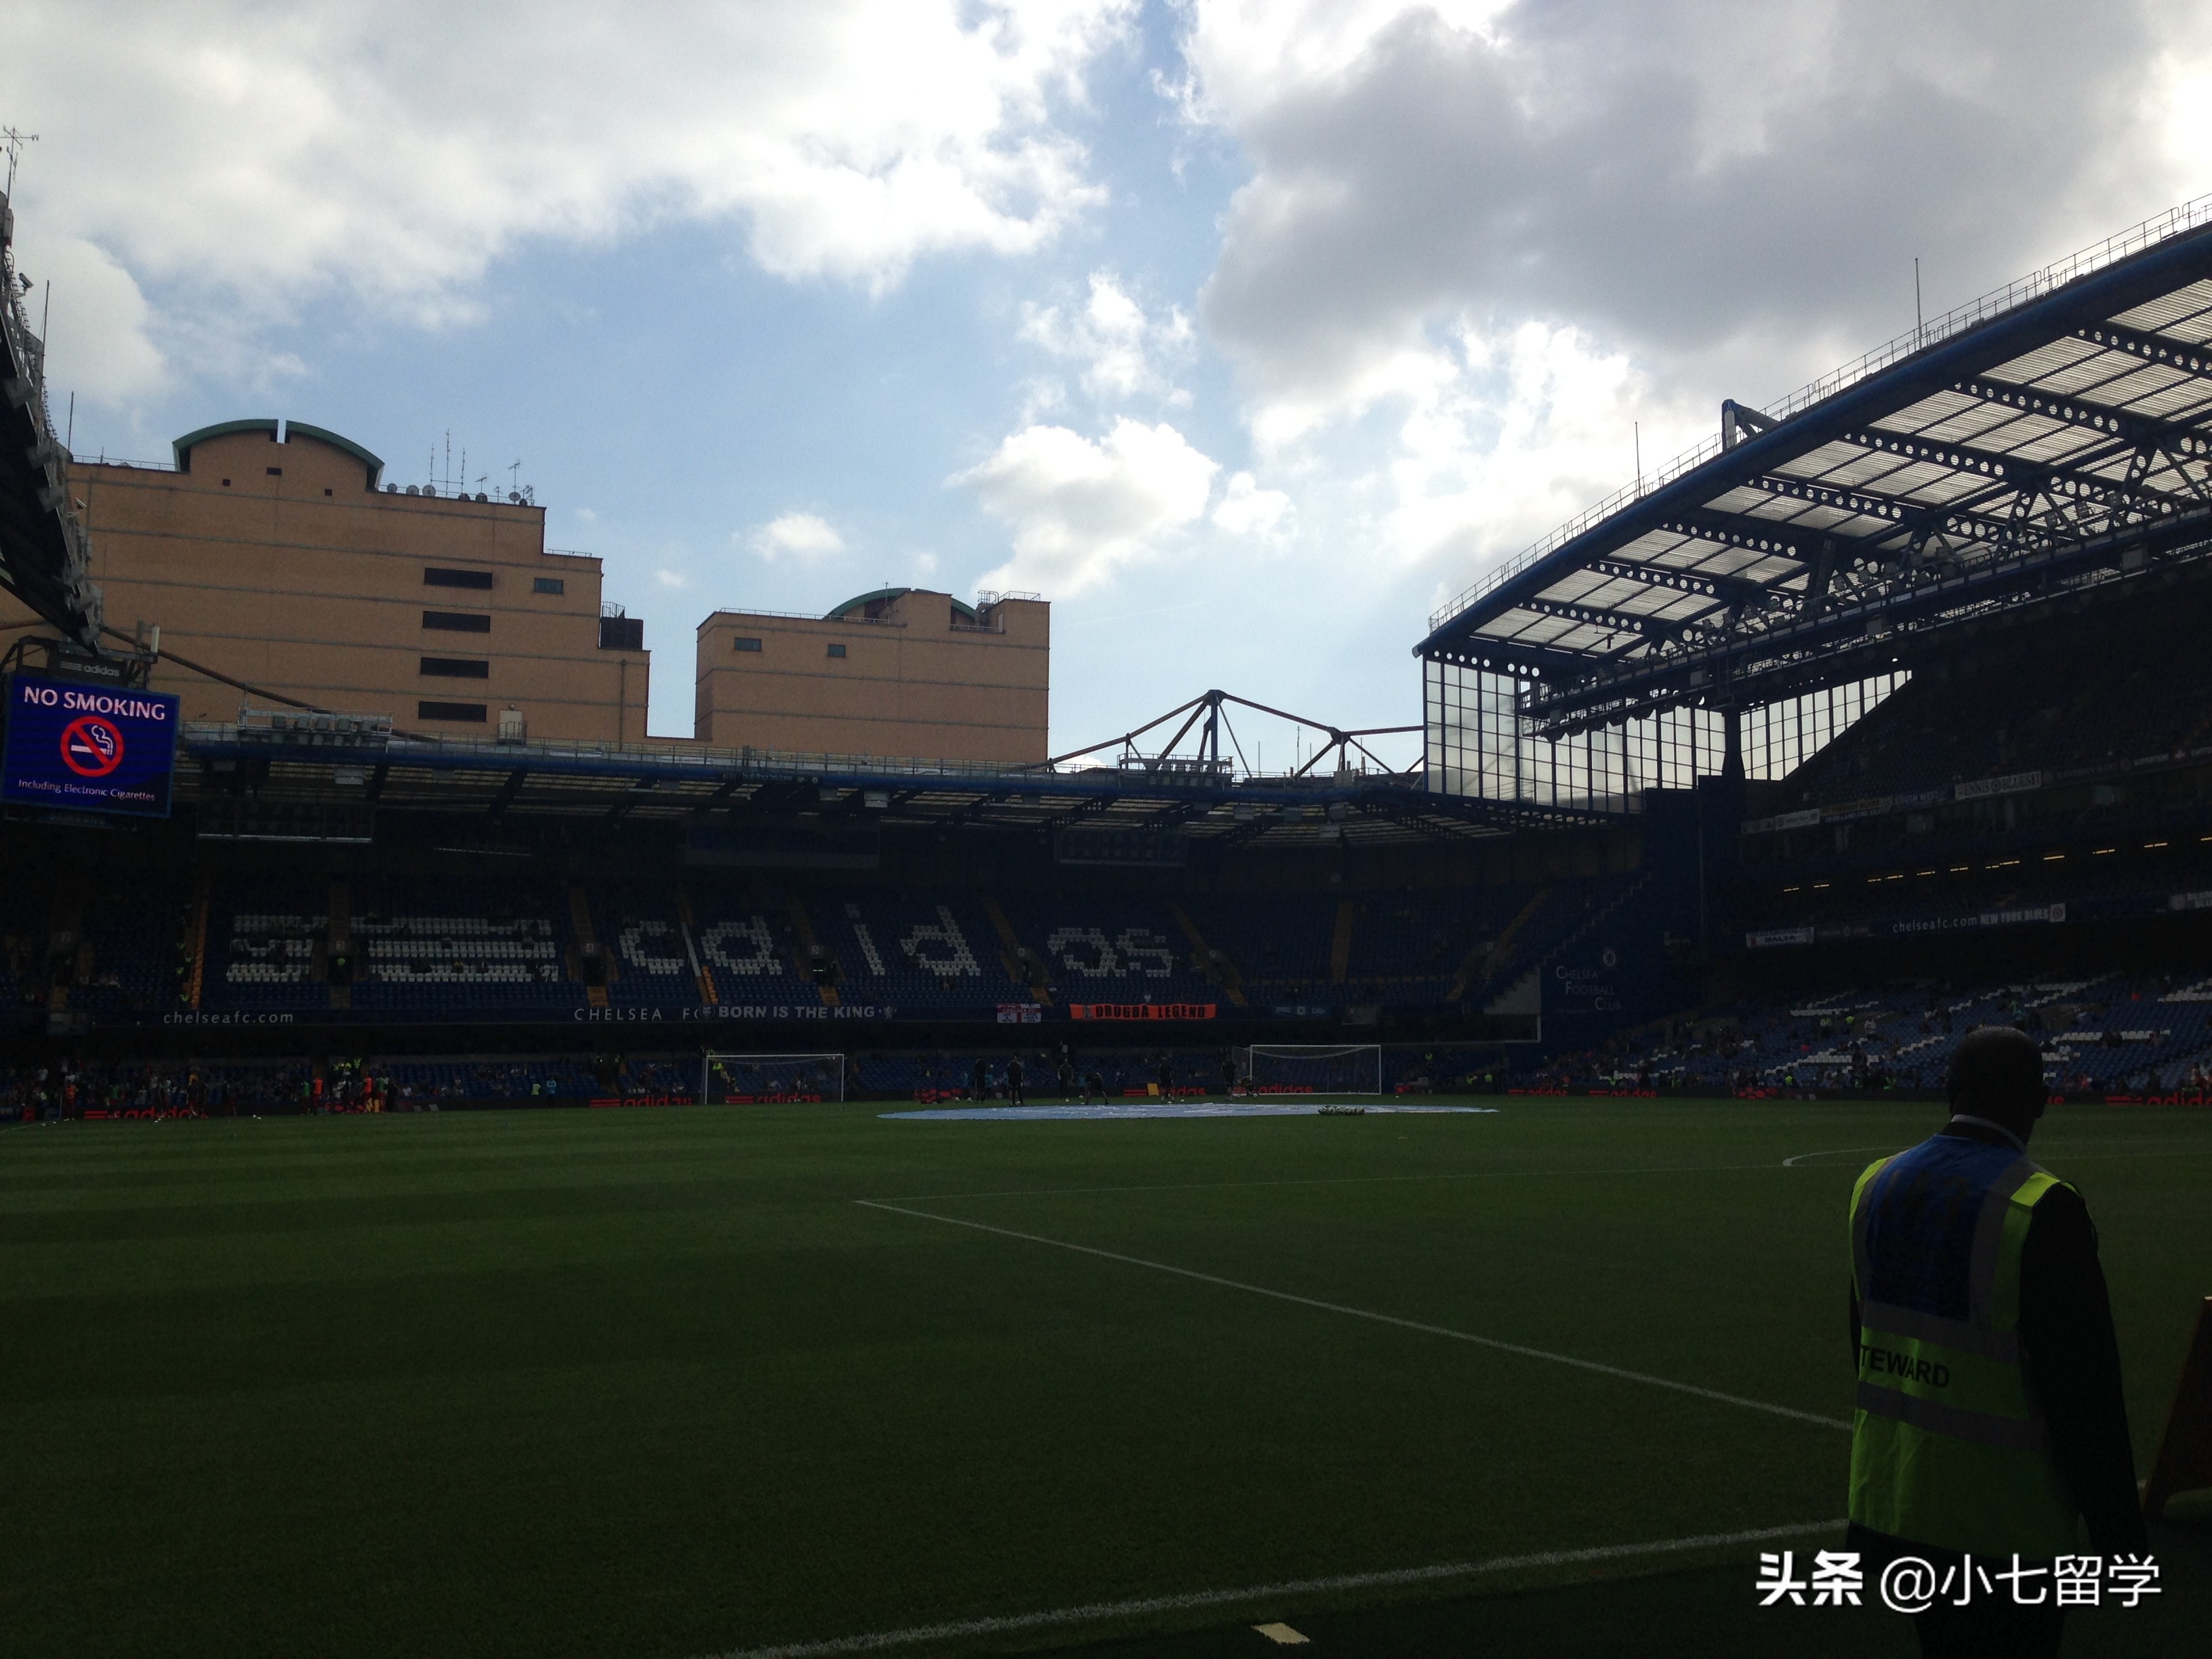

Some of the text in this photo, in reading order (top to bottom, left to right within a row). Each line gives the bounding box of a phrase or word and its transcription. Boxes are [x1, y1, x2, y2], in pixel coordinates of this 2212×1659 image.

[83, 664, 120, 676] adidas
[24, 686, 166, 720] NO SMOKING
[18, 779, 155, 802] Including Electronic Cigarettes
[1892, 916, 1978, 934] chelseafc.com
[163, 1010, 293, 1024] chelseafc.com
[574, 1008, 662, 1021] CHELSEA
[718, 1006, 876, 1019] BORN IS THE KING
[1158, 1006, 1206, 1018] LEGEND
[623, 1094, 693, 1107] adidas
[1861, 1345, 1950, 1389] TEWARD
